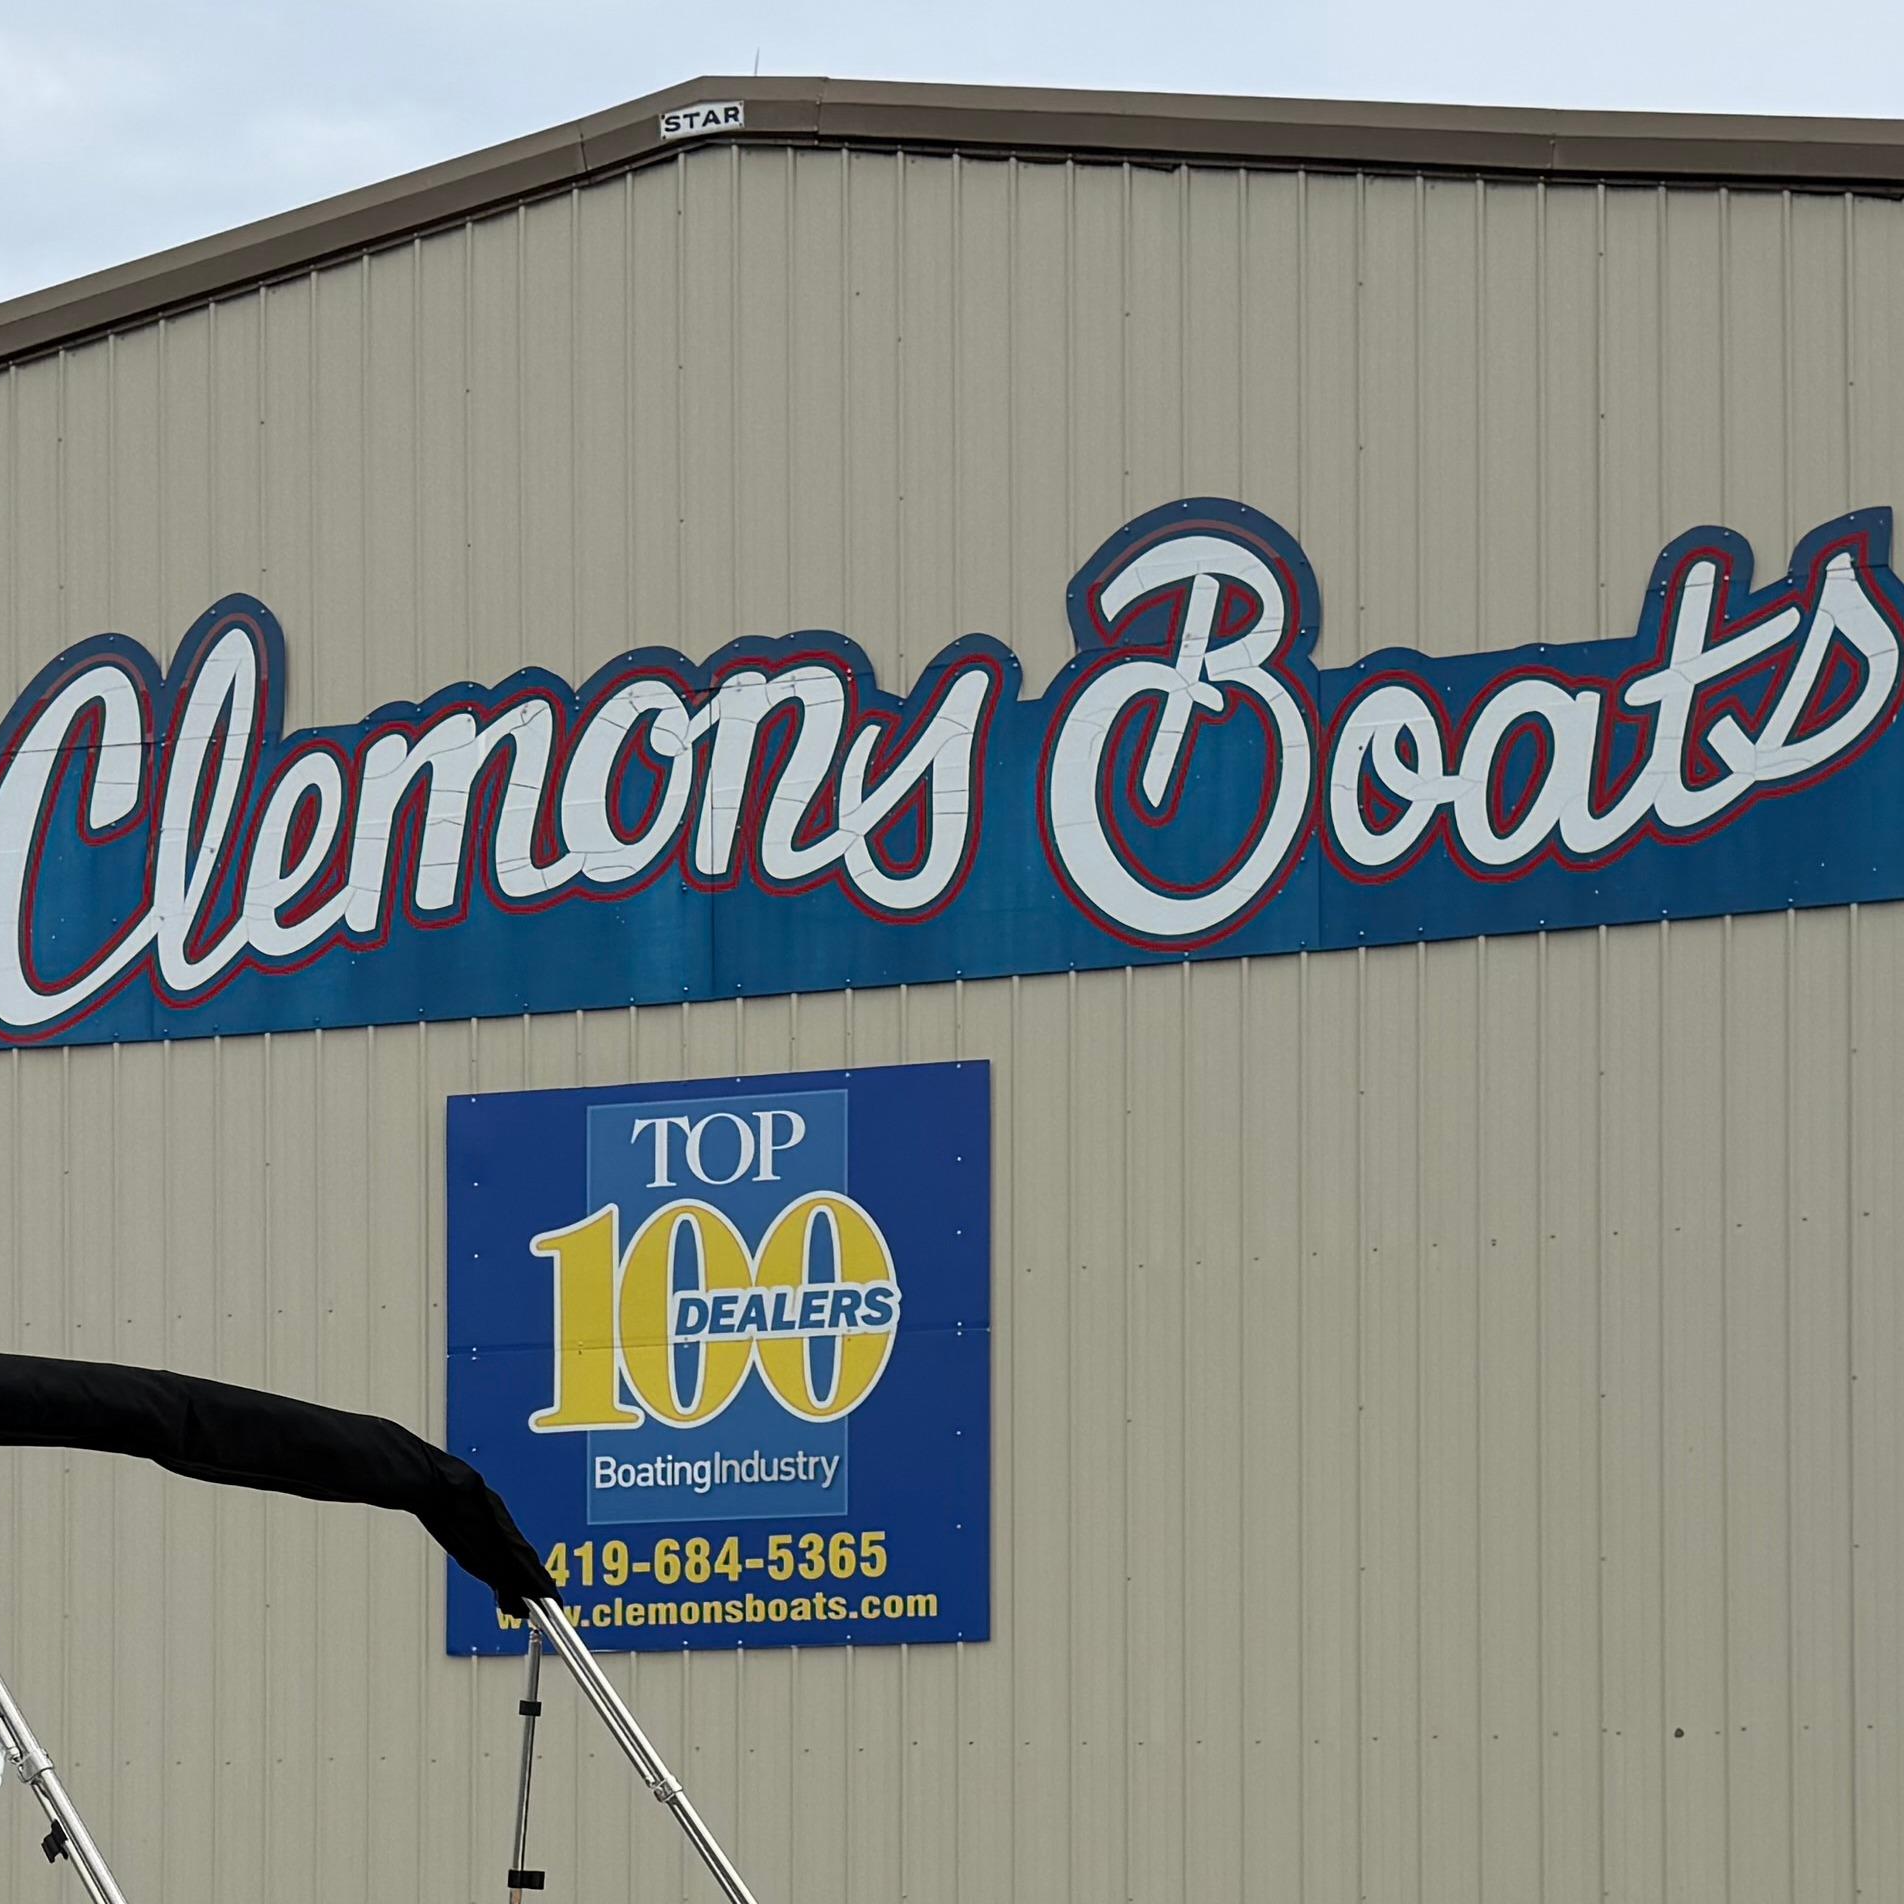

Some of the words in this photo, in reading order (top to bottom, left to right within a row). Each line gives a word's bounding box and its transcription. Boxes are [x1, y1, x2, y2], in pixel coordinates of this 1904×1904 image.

[664, 106, 740, 132] STAR
[1050, 531, 1903, 938] Boats
[630, 1109, 806, 1189] TOP
[528, 1190, 898, 1434] 100
[673, 1284, 896, 1337] DEALERS
[545, 1531, 888, 1587] 419-684-5365
[496, 1592, 938, 1630] ww.clemonsboats.com
